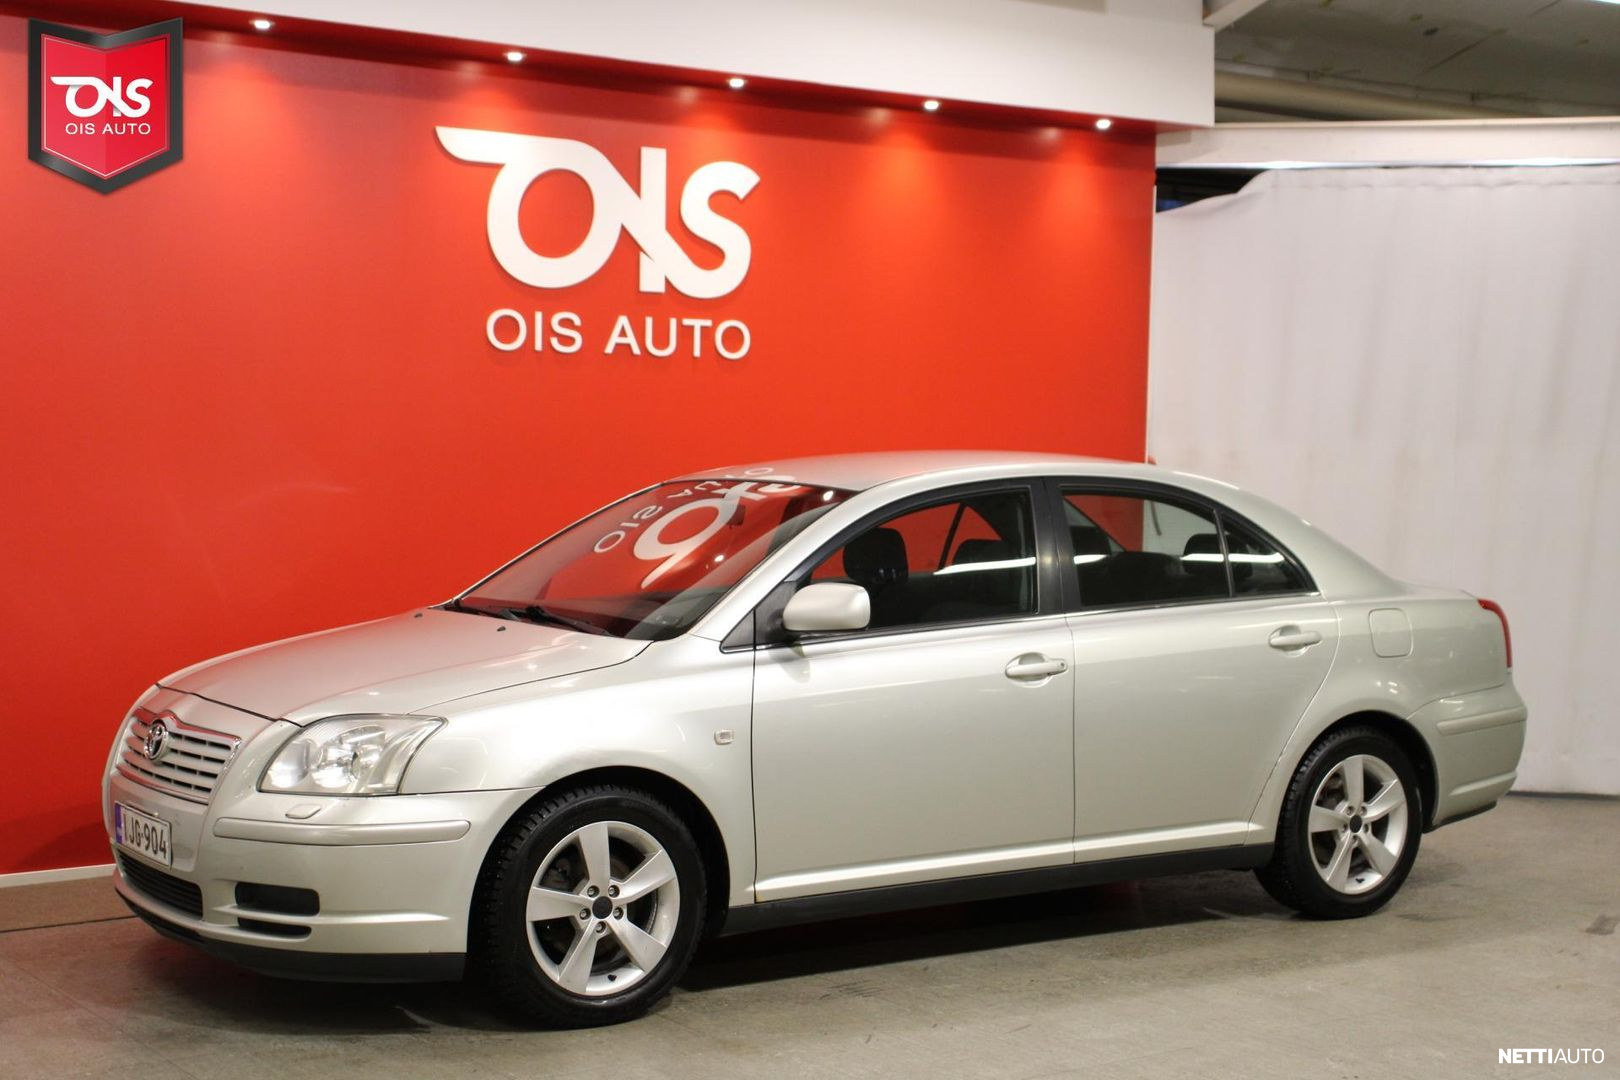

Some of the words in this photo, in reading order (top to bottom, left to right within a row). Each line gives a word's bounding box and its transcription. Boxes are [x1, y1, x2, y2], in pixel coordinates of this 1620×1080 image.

[435, 126, 761, 299] OIS
[486, 308, 583, 354] OIS
[604, 315, 751, 360] AUTO
